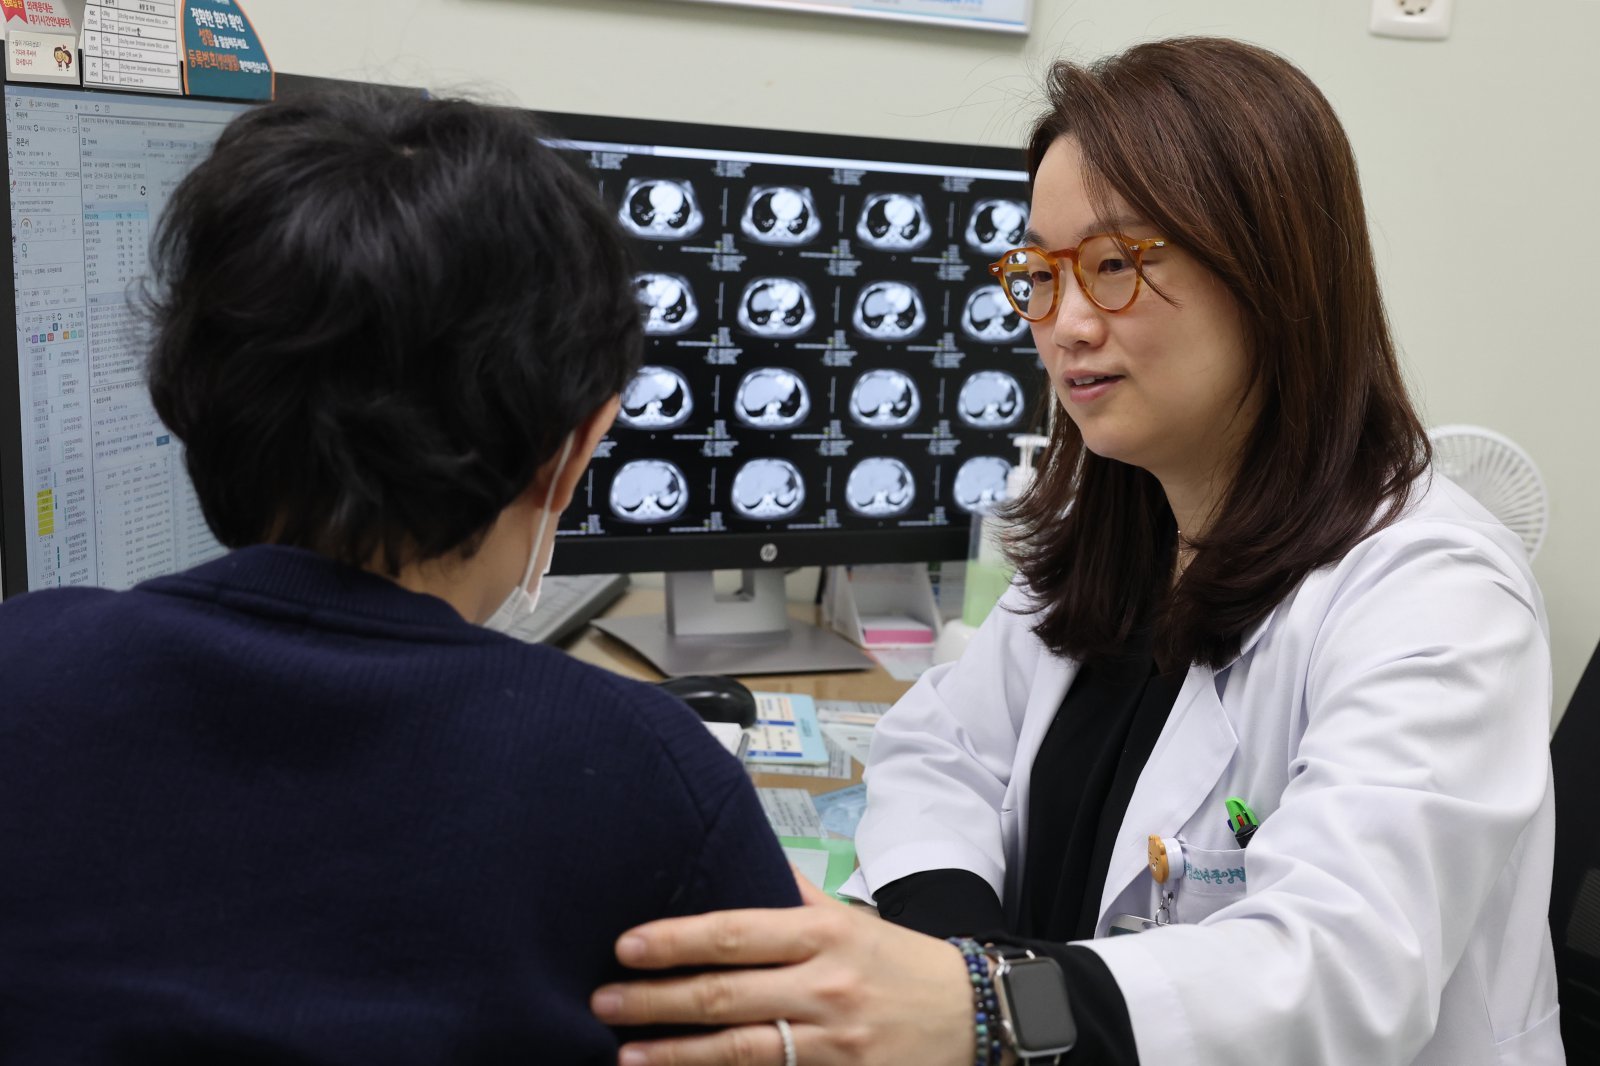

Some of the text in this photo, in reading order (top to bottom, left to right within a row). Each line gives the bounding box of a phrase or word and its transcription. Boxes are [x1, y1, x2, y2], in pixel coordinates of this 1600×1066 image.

[27, 1, 54, 13] 외래응대는
[190, 7, 215, 27] 정확한
[212, 10, 229, 29] 환자
[227, 13, 246, 32] 확인
